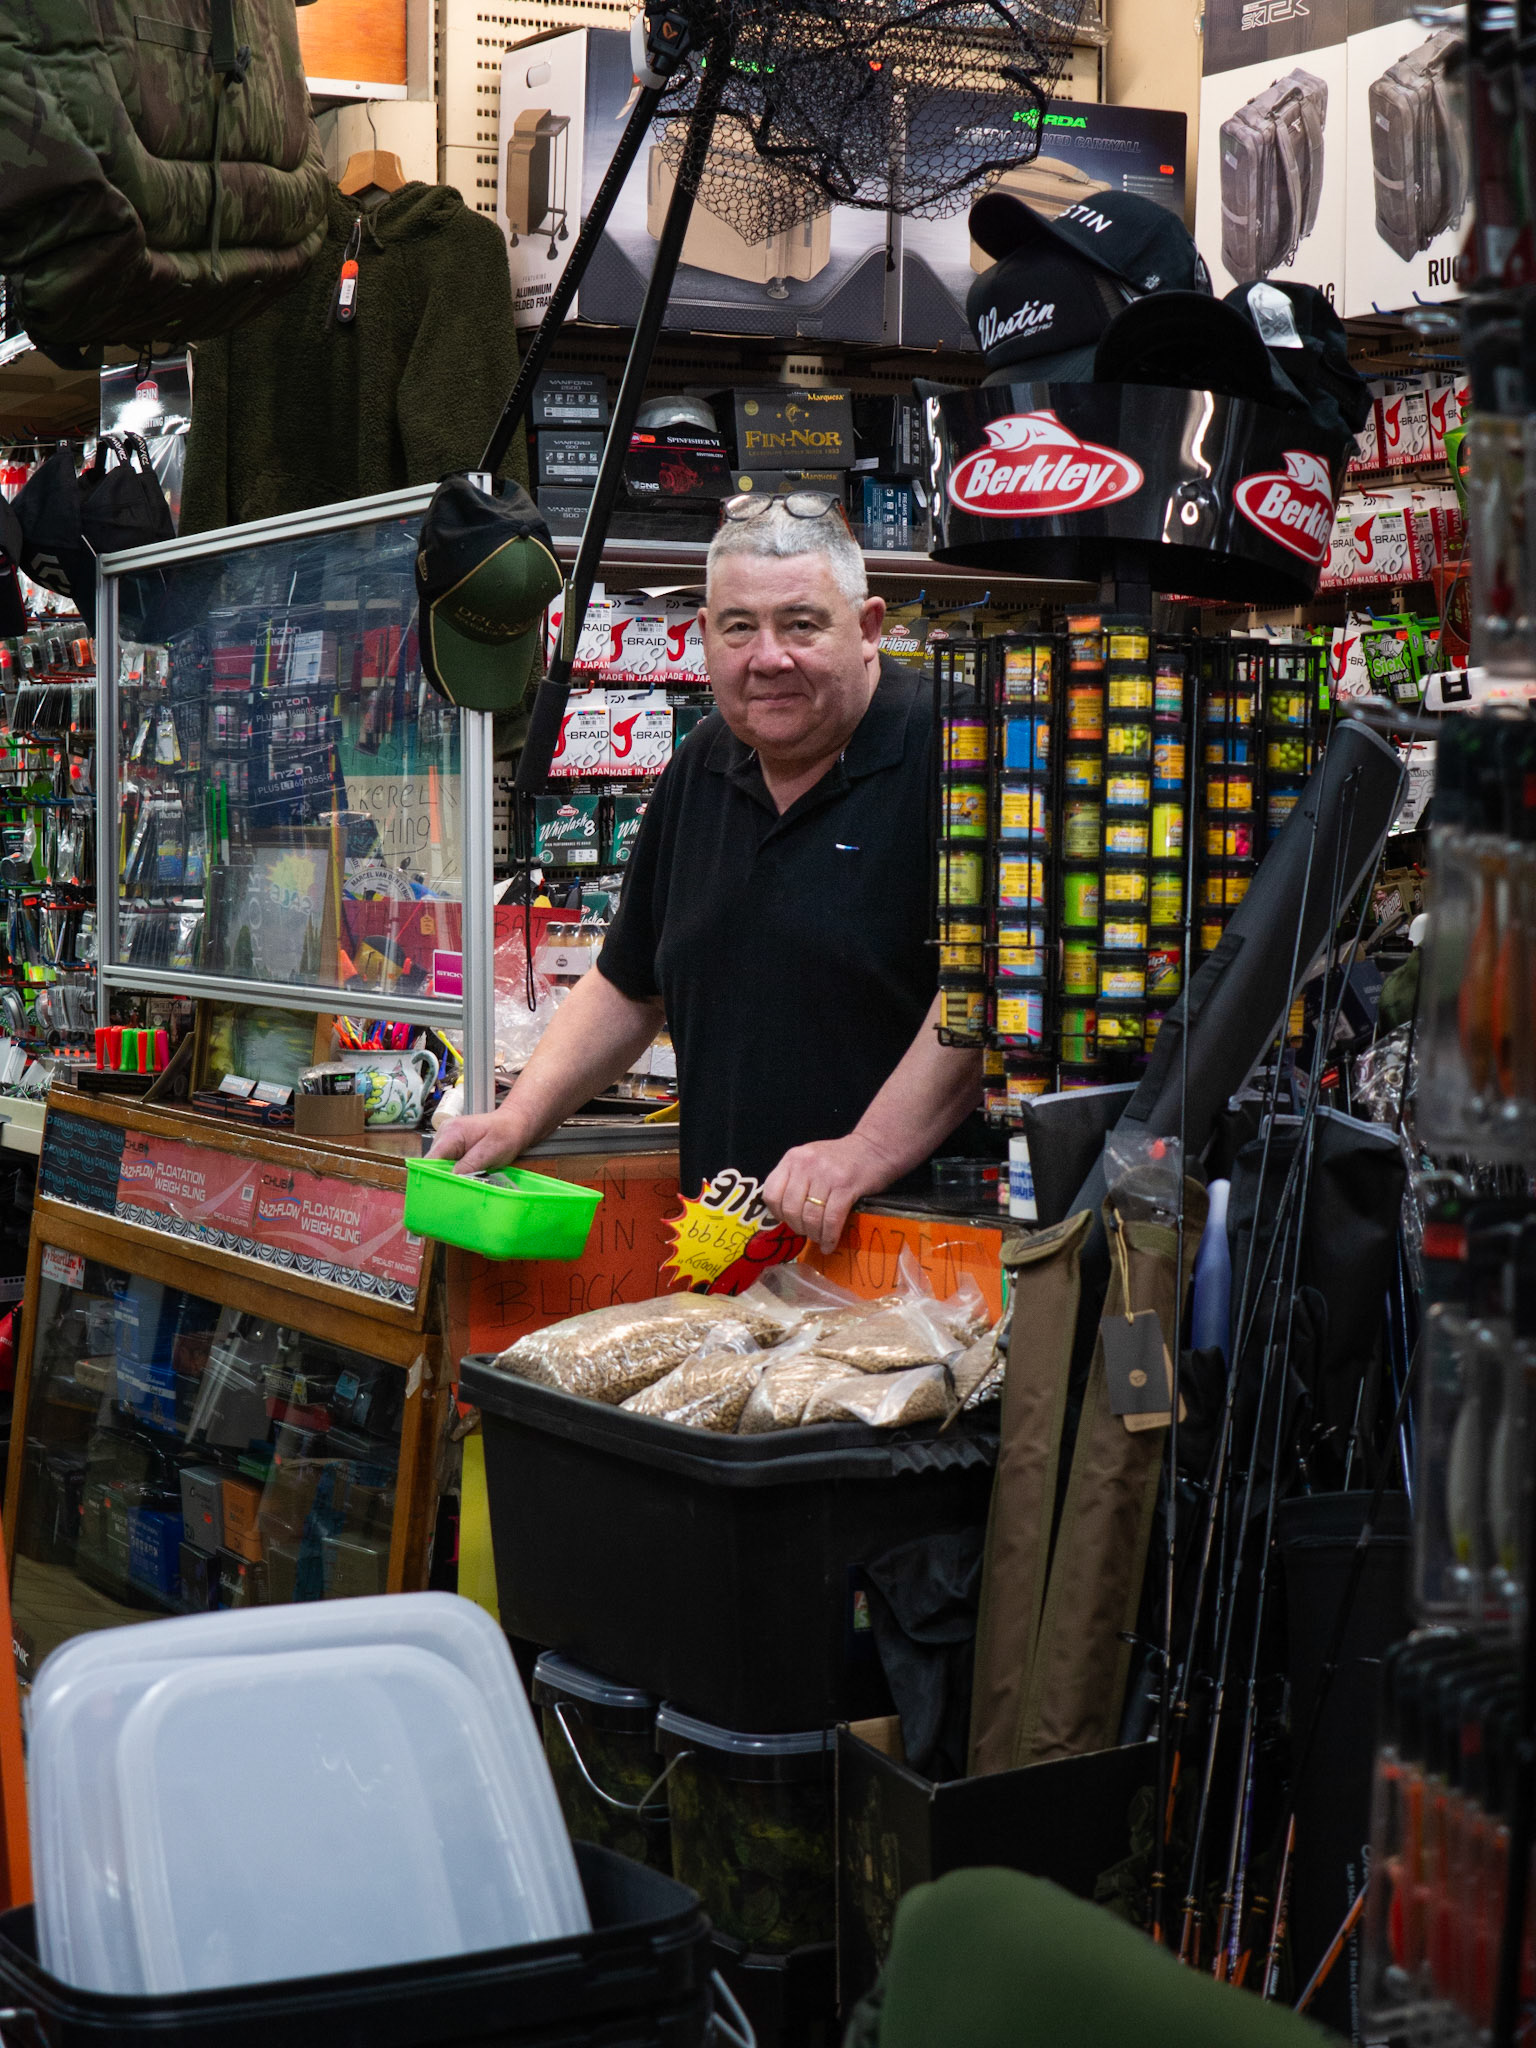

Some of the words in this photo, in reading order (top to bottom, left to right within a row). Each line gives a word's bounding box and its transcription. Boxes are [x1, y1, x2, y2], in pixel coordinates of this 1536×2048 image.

[1055, 204, 1113, 234] STIN
[515, 283, 552, 299] ALUMINIUM
[514, 298, 535, 312] ELDED
[978, 300, 1056, 351] Westin
[136, 387, 158, 400] PENN
[808, 392, 845, 403] Marquesa
[744, 428, 843, 449] FIN-NOR
[1387, 457, 1405, 465] MADE
[1412, 454, 1432, 463] JAPAN
[963, 453, 1109, 499] Berkley
[1374, 542, 1407, 575] x8
[1359, 575, 1379, 584] MADE
[1380, 574, 1388, 582] IN
[1389, 572, 1413, 582] JAPAN
[573, 661, 582, 669] IN
[583, 661, 611, 669] JAPAN
[620, 647, 665, 675] x8
[599, 673, 623, 681] MADE
[625, 673, 635, 681] IN
[637, 673, 666, 682] JAPAN
[685, 673, 694, 681] IN
[563, 739, 608, 769] x8
[629, 739, 672, 769] x8
[550, 768, 567, 776] ADE
[580, 767, 610, 776] JAPAN
[610, 768, 632, 777] MADE
[258, 783, 280, 794] PLUS
[539, 811, 589, 842] Whiplash
[156, 1162, 206, 1187] FLOATATION
[263, 1174, 288, 1190] CHUB
[154, 1177, 180, 1195] WEIGH
[181, 1185, 206, 1202] SLING
[302, 1200, 361, 1227] FLOATATION
[301, 1216, 332, 1237] WEIGH
[332, 1225, 361, 1245] SLING
[483, 1269, 633, 1329] BLACK
